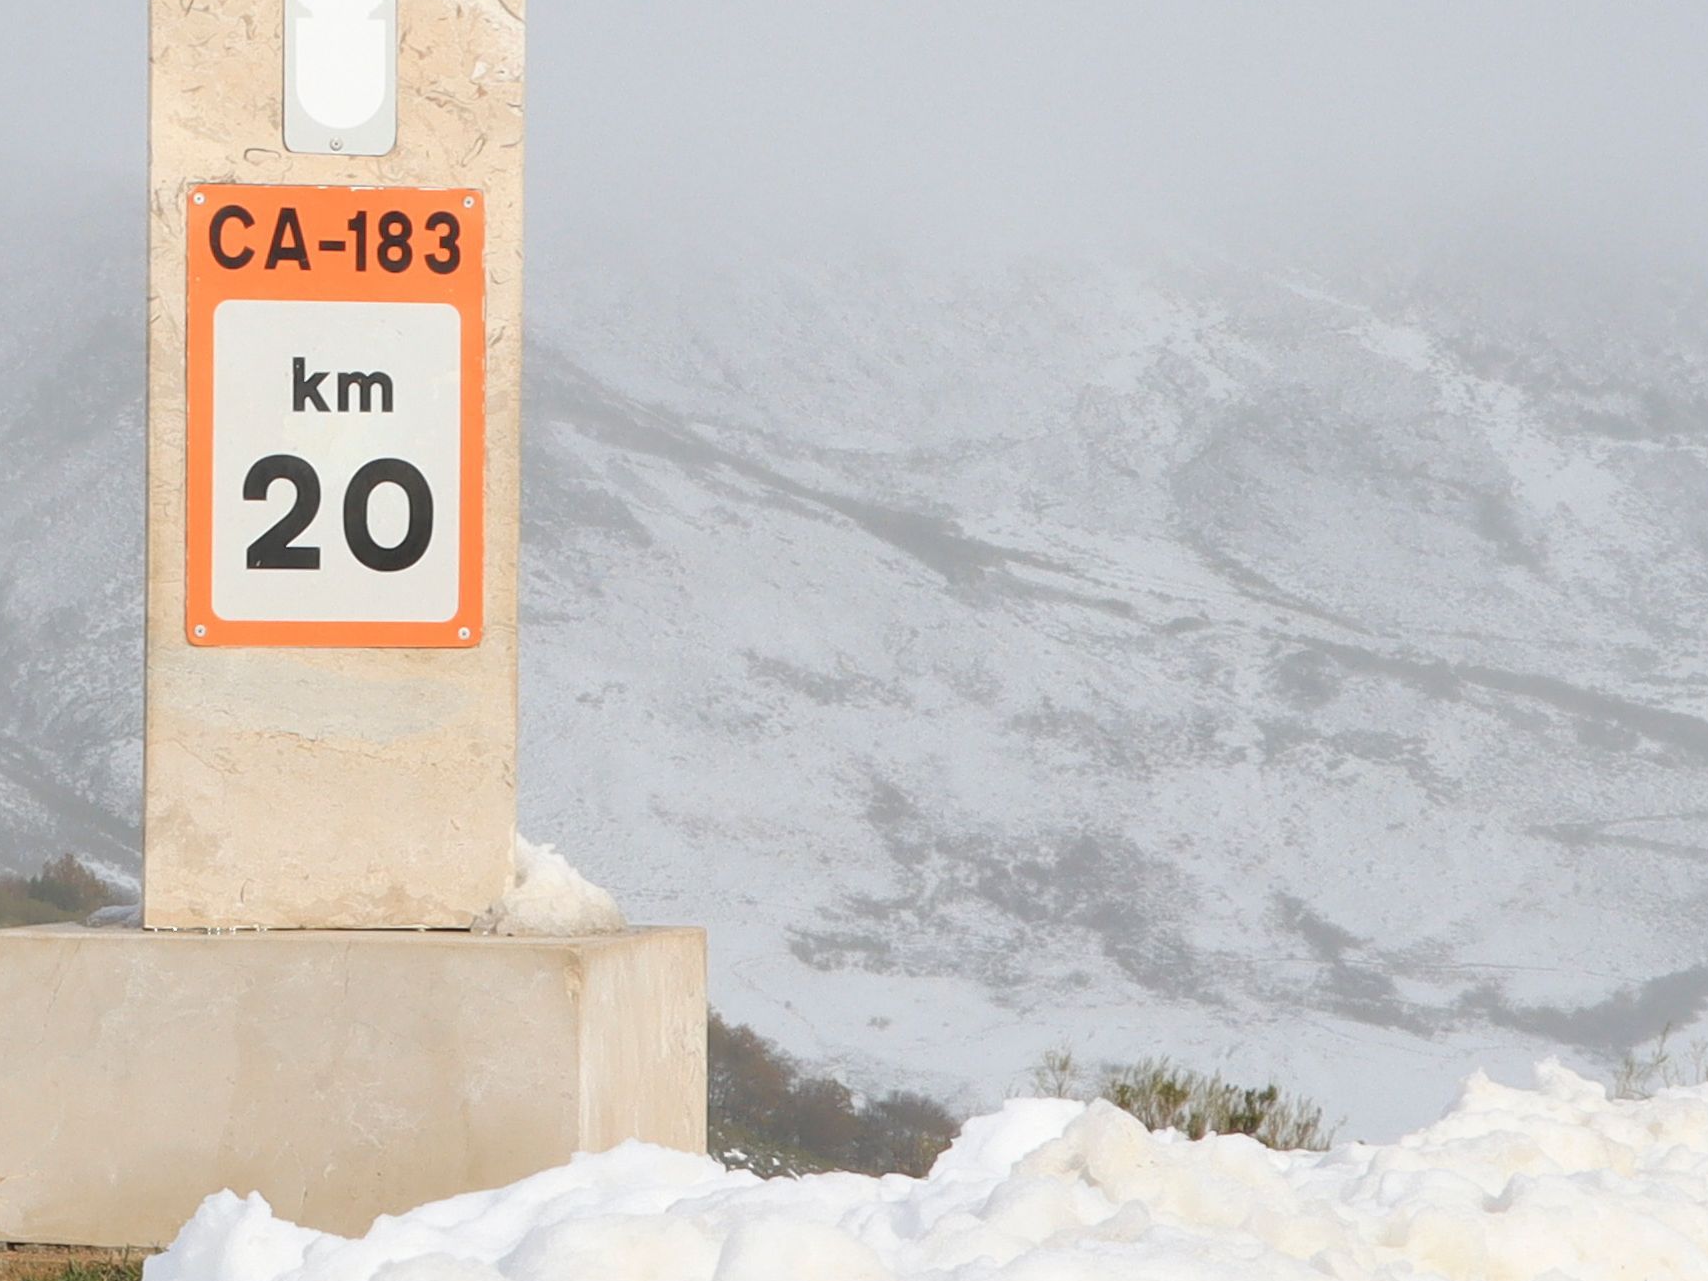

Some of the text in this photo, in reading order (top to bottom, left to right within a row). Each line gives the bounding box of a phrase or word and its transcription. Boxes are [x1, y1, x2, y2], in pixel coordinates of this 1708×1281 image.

[208, 204, 462, 274] CA-183
[292, 357, 394, 413] km
[242, 454, 434, 572] 20
